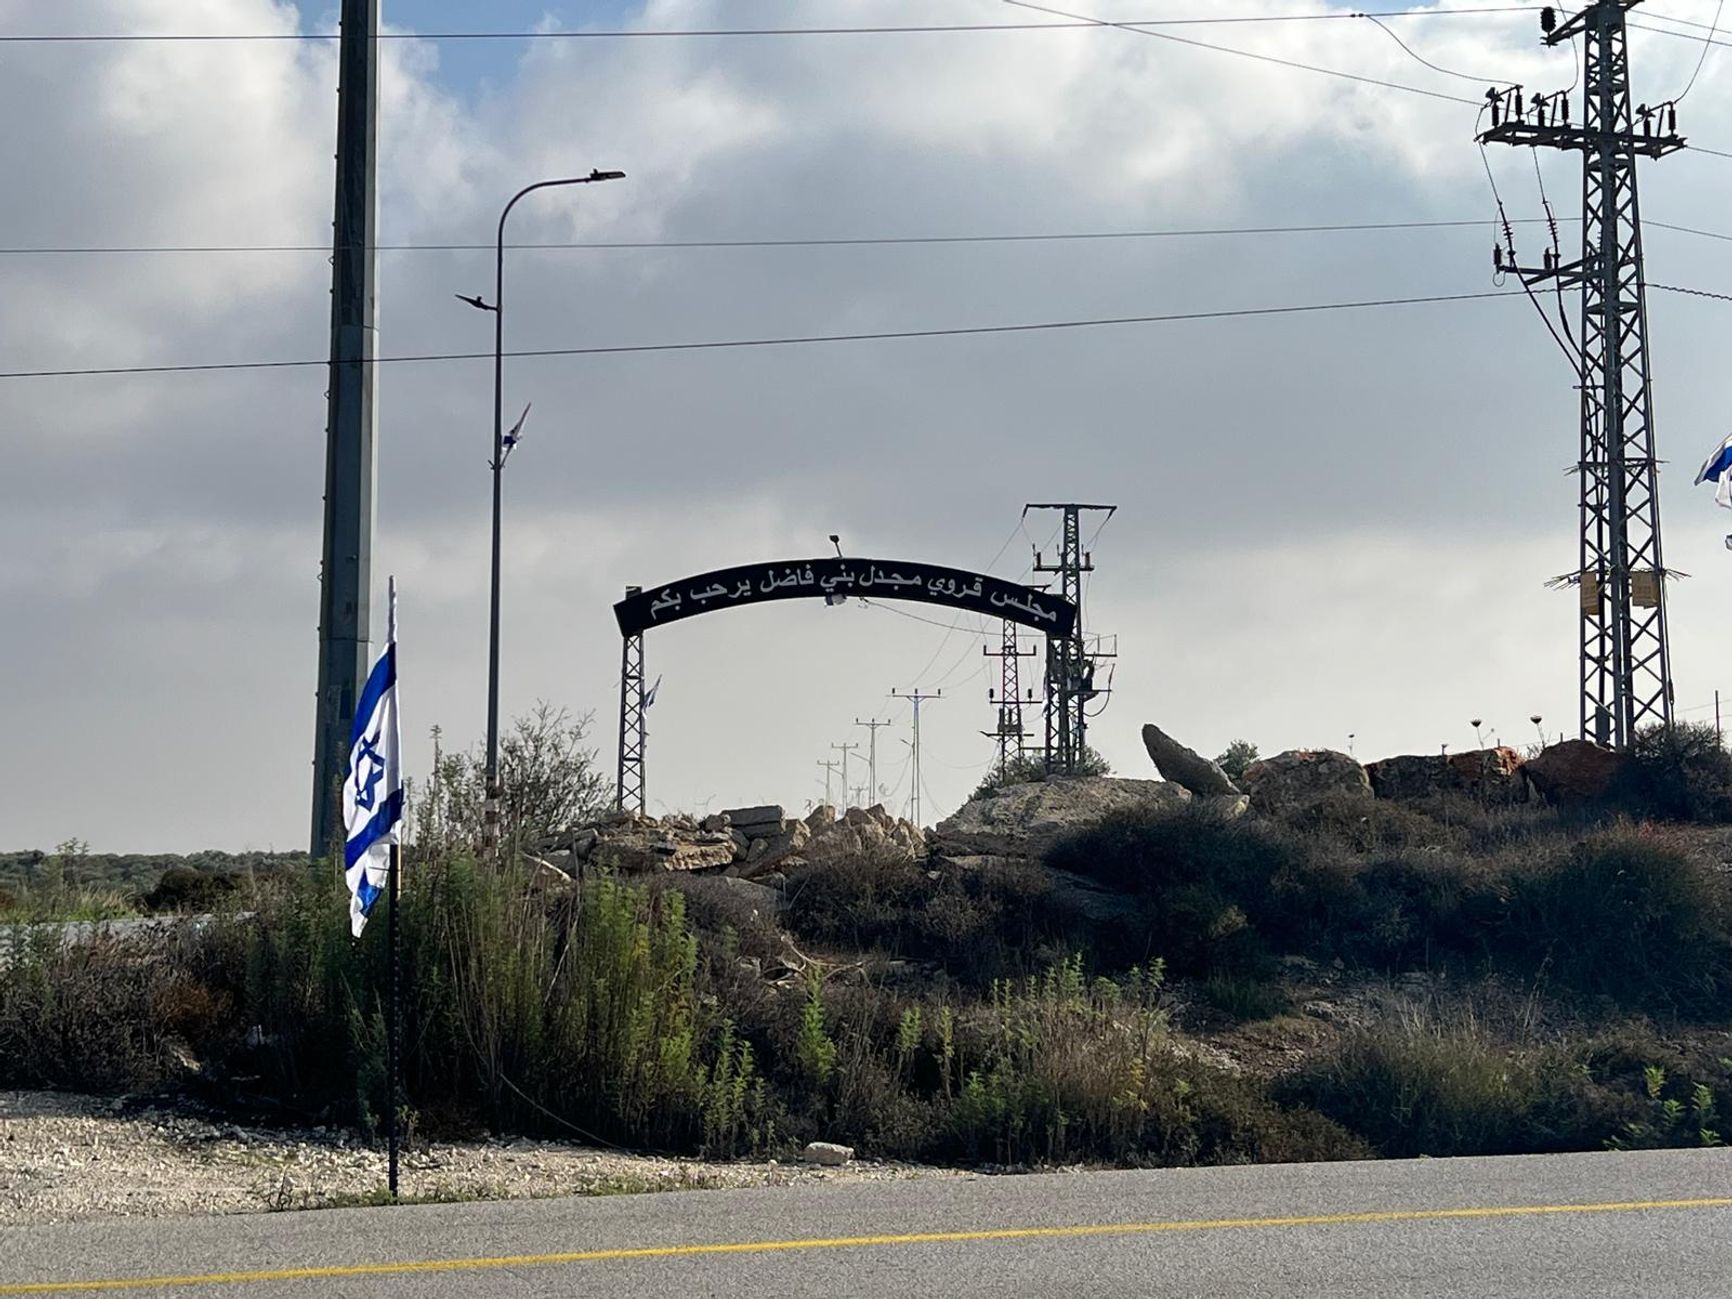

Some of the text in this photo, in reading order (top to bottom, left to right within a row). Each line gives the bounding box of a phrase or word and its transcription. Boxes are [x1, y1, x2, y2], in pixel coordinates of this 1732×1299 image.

[649, 564, 1056, 622] مجلس قروي مجدل بني فاضل يرحب بكم
